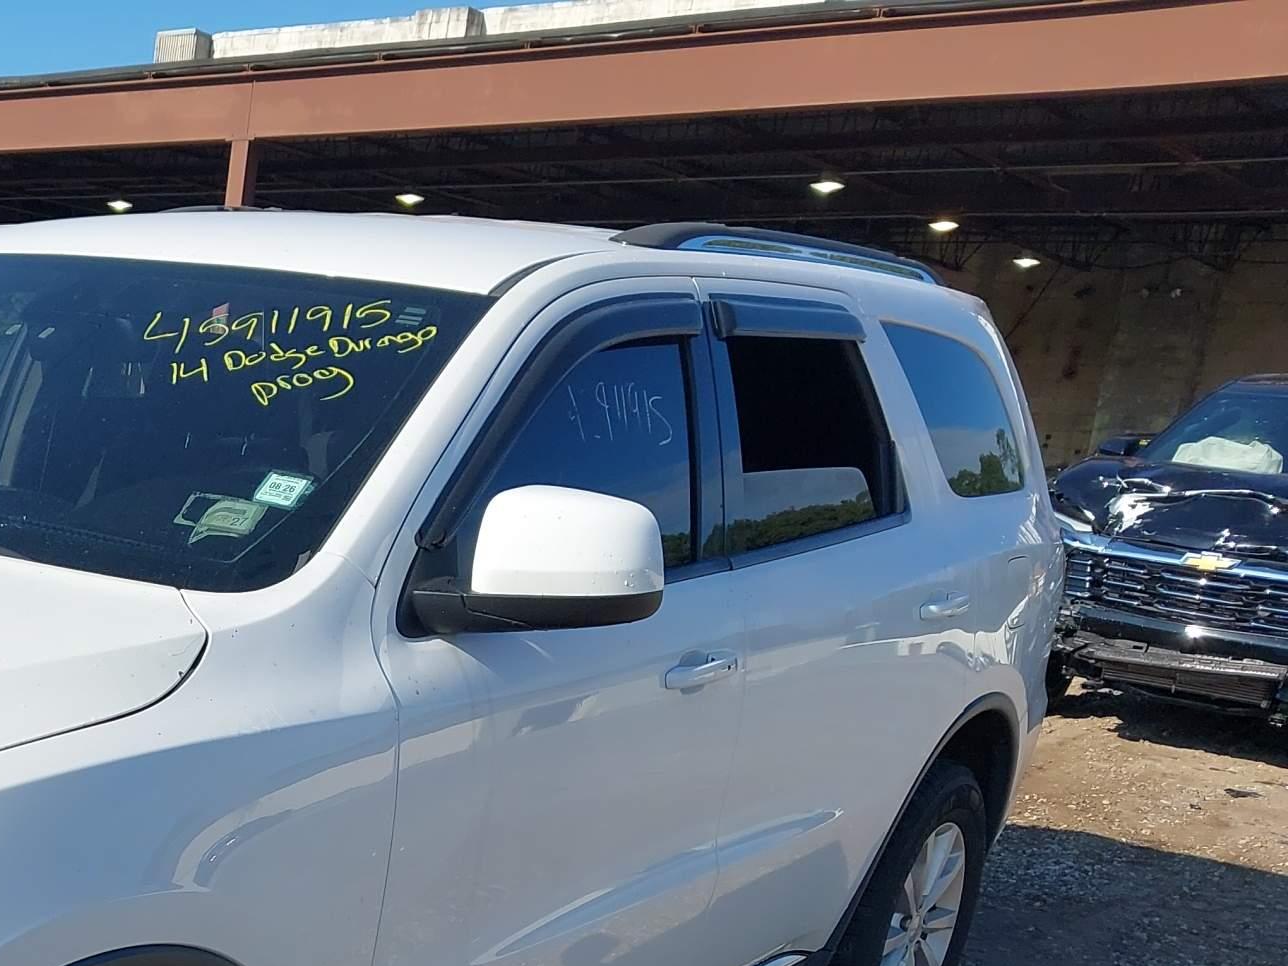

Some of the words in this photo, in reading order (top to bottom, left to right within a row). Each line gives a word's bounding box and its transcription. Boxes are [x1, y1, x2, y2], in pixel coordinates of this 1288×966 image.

[143, 300, 392, 354] 45911915
[170, 358, 209, 384] 14
[223, 342, 326, 371] Dodge
[328, 326, 438, 354] Durango
[269, 481, 282, 490] 08
[282, 484, 296, 492] 26
